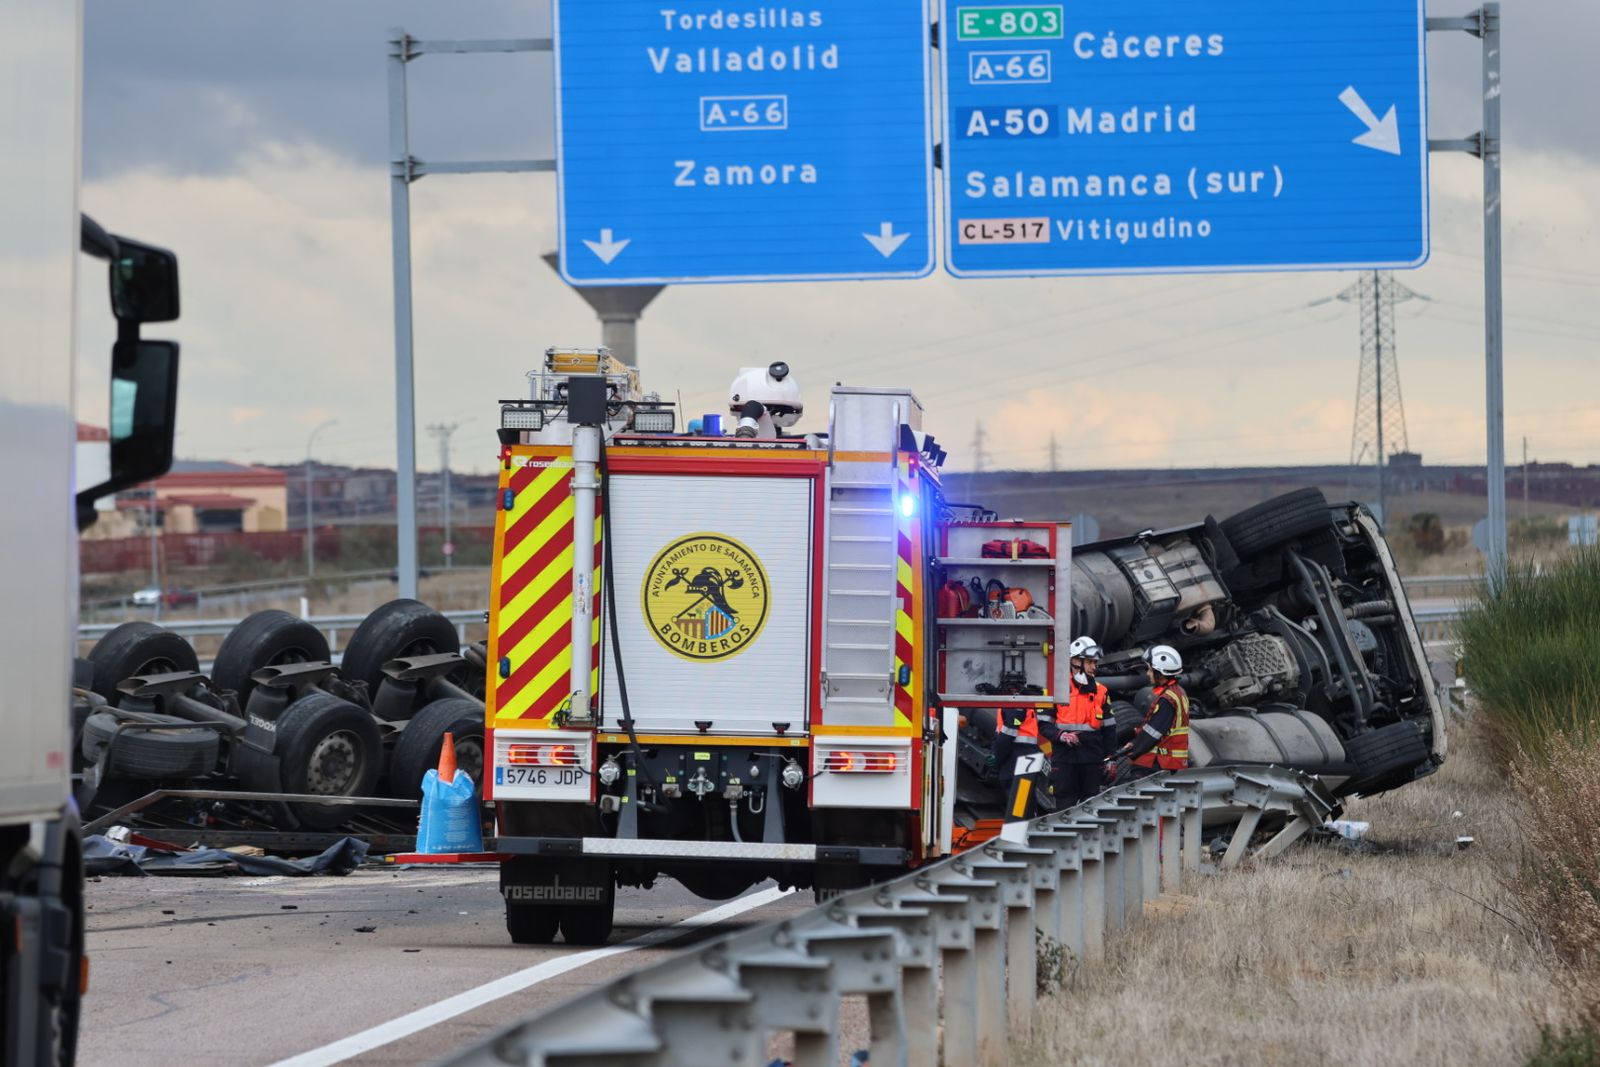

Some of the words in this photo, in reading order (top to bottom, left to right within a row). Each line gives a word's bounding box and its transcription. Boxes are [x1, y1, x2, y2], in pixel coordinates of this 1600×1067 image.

[661, 9, 823, 30] Tordesillas
[963, 11, 1059, 35] E-803
[647, 44, 839, 73] Valladolid
[1073, 31, 1224, 59] Cáceres
[973, 55, 1047, 79] A-66
[706, 103, 782, 124] A-66
[966, 108, 1049, 136] A-50
[1067, 105, 1196, 133] Madrid
[674, 160, 817, 187] Zamora
[965, 171, 1172, 198] Salamanca
[1188, 166, 1284, 199] (sur)
[963, 222, 1045, 240] CL-517
[1057, 217, 1212, 244] Vitigudino
[652, 543, 707, 598] AYUNTAMIENTO
[710, 543, 723, 553] DE
[723, 548, 760, 599] SALAMANCA
[660, 623, 751, 654] BOMBEROS
[507, 769, 547, 784] 5746
[554, 769, 583, 785] JDP
[1024, 755, 1036, 773] 7
[504, 874, 603, 900] rosenbauer
